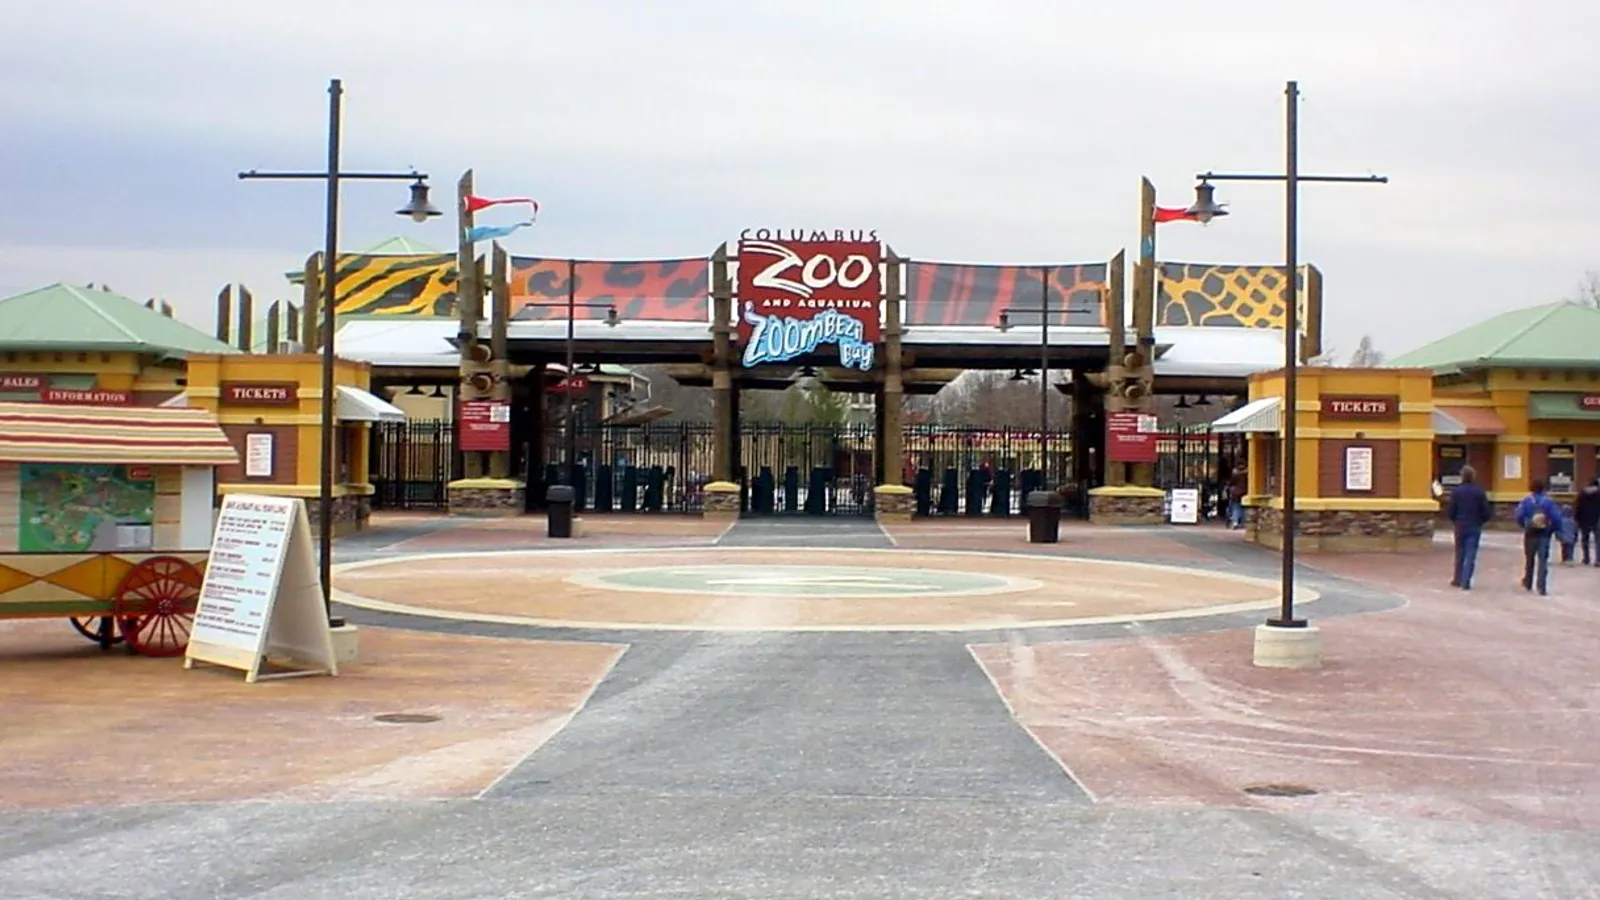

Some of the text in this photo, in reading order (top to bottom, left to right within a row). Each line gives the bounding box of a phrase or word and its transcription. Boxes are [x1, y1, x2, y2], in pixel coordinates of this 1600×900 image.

[740, 228, 878, 242] COLUMBUS
[742, 240, 873, 298] ZOO
[762, 299, 873, 308] AND AQUARIUM
[3, 377, 39, 388] SALES
[48, 390, 127, 402] INFORMATION
[232, 388, 287, 399] TICKETS
[1331, 401, 1386, 412] TICKETS
